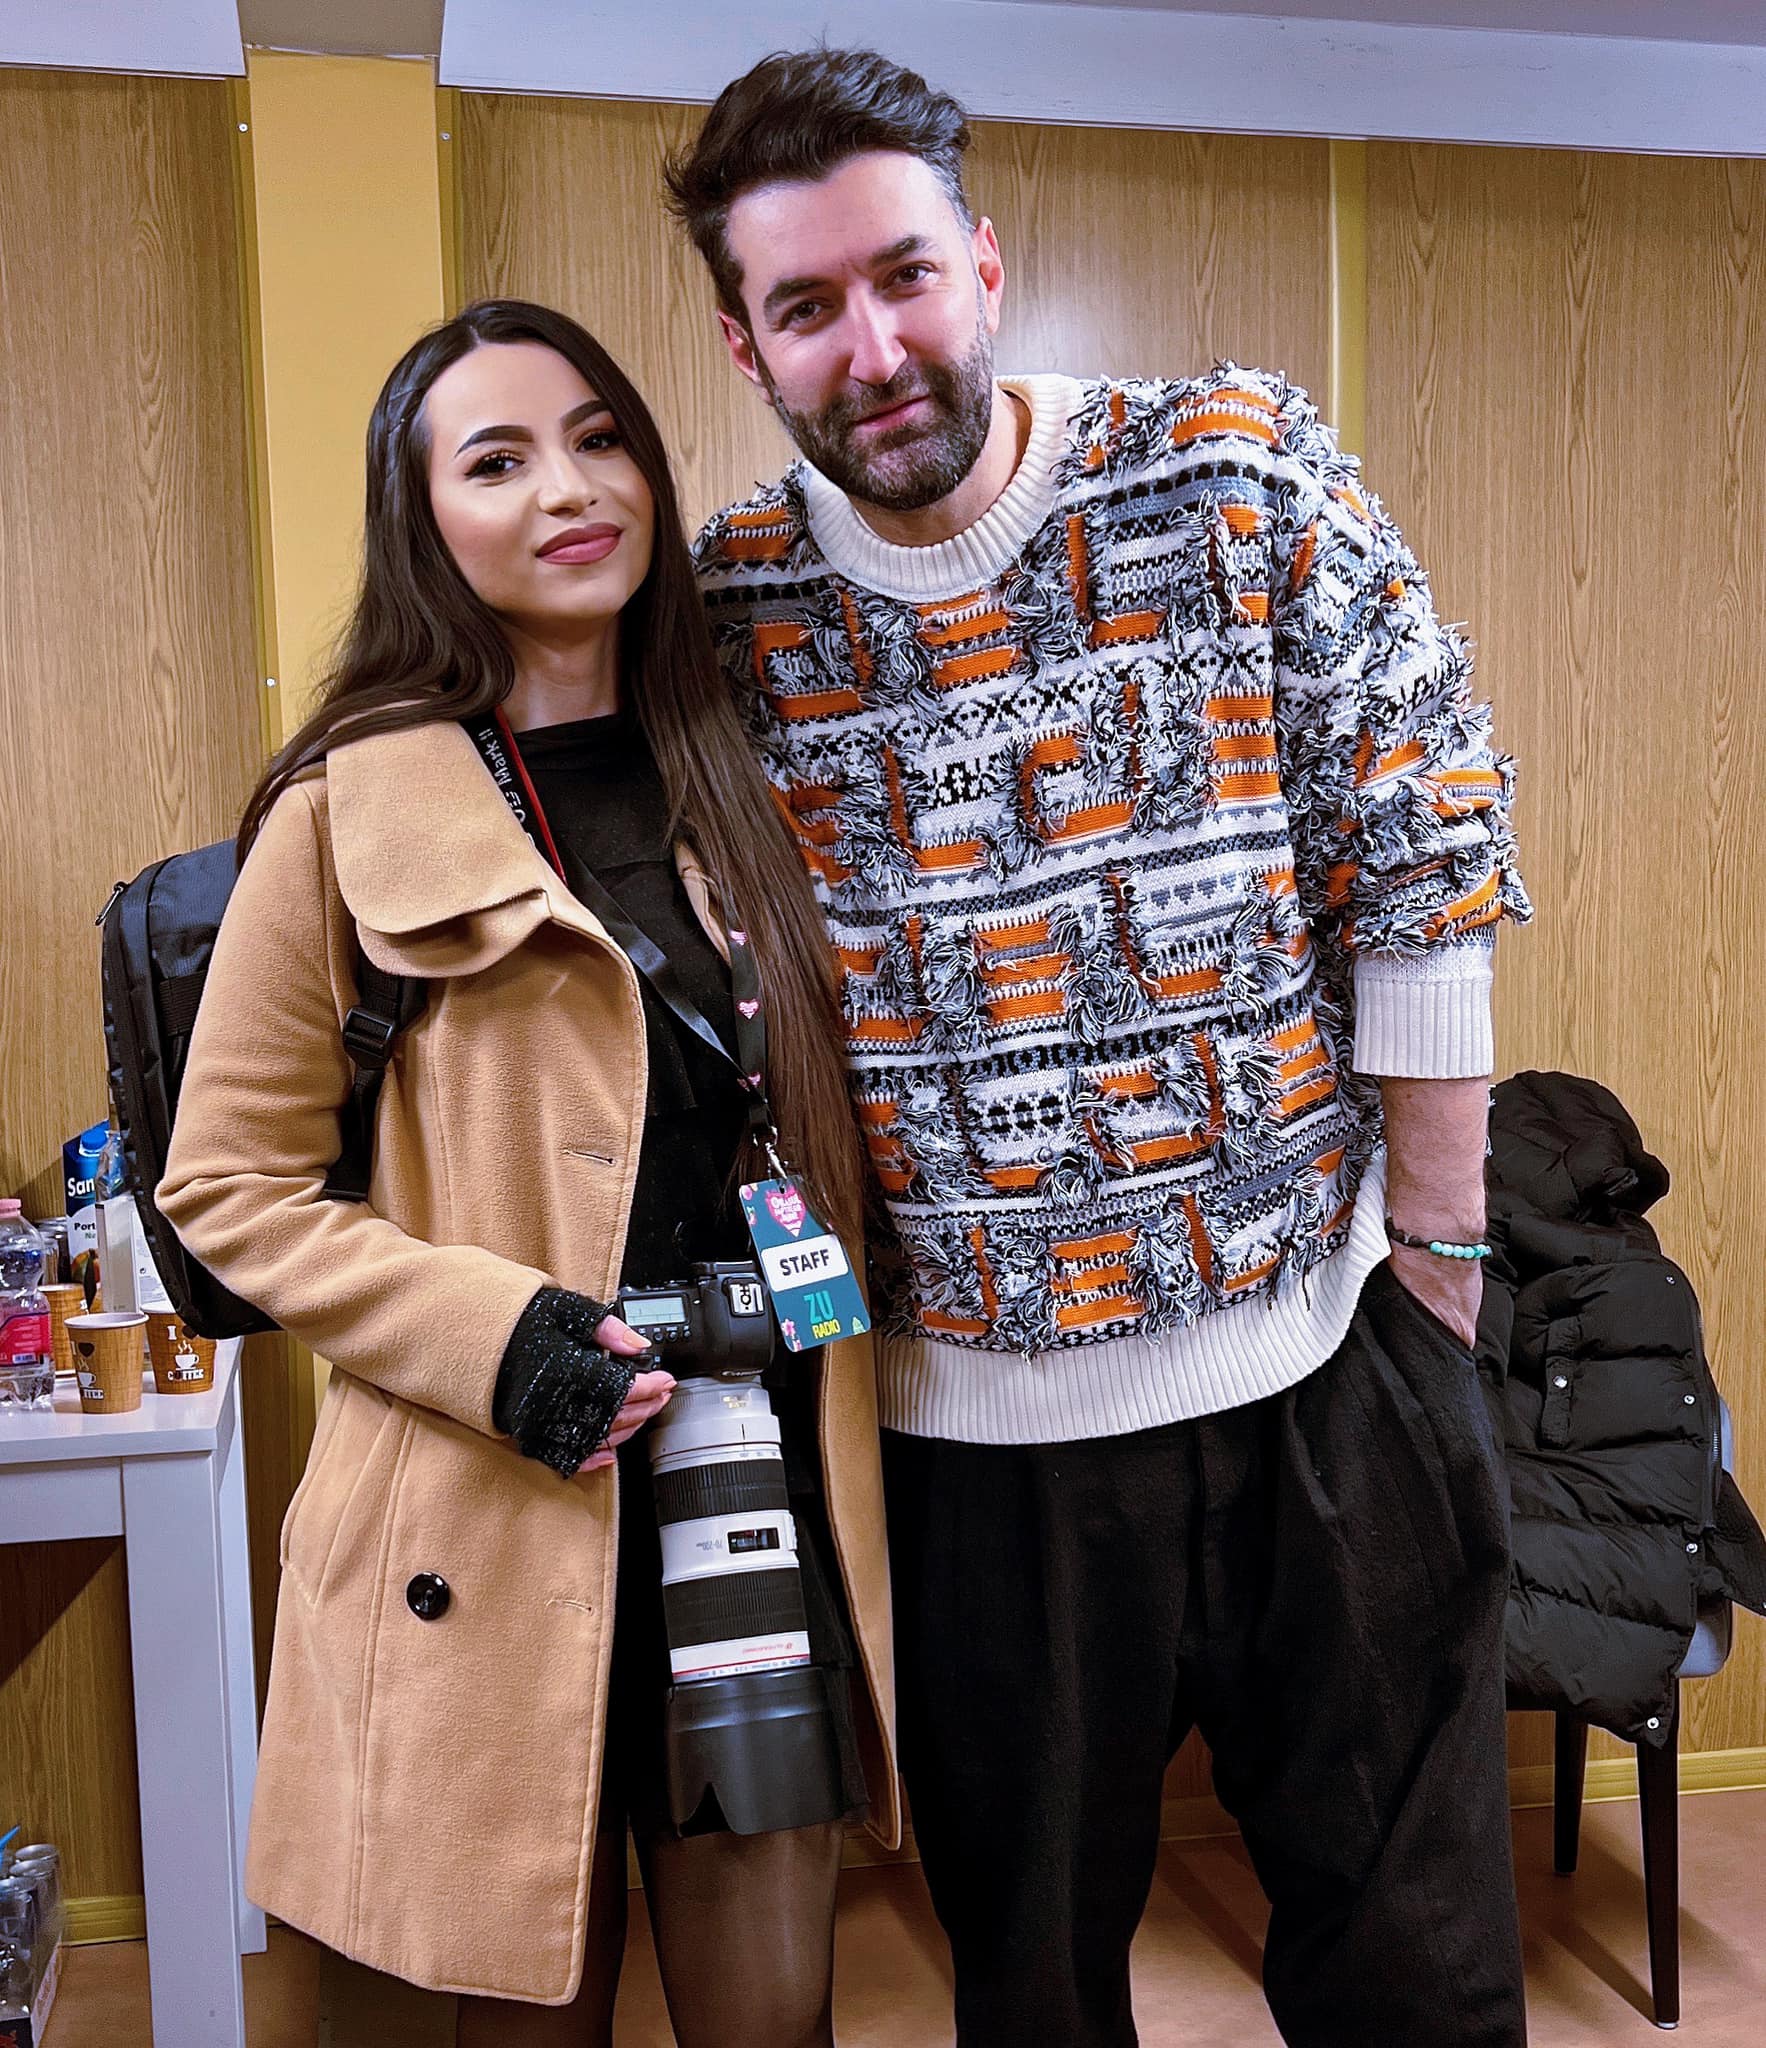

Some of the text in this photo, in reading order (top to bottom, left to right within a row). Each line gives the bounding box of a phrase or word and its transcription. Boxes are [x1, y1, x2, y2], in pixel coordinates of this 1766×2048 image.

[485, 740, 512, 785] Mark
[779, 1249, 829, 1276] STAFF
[804, 1291, 834, 1324] ZU
[812, 1319, 841, 1339] RADIO
